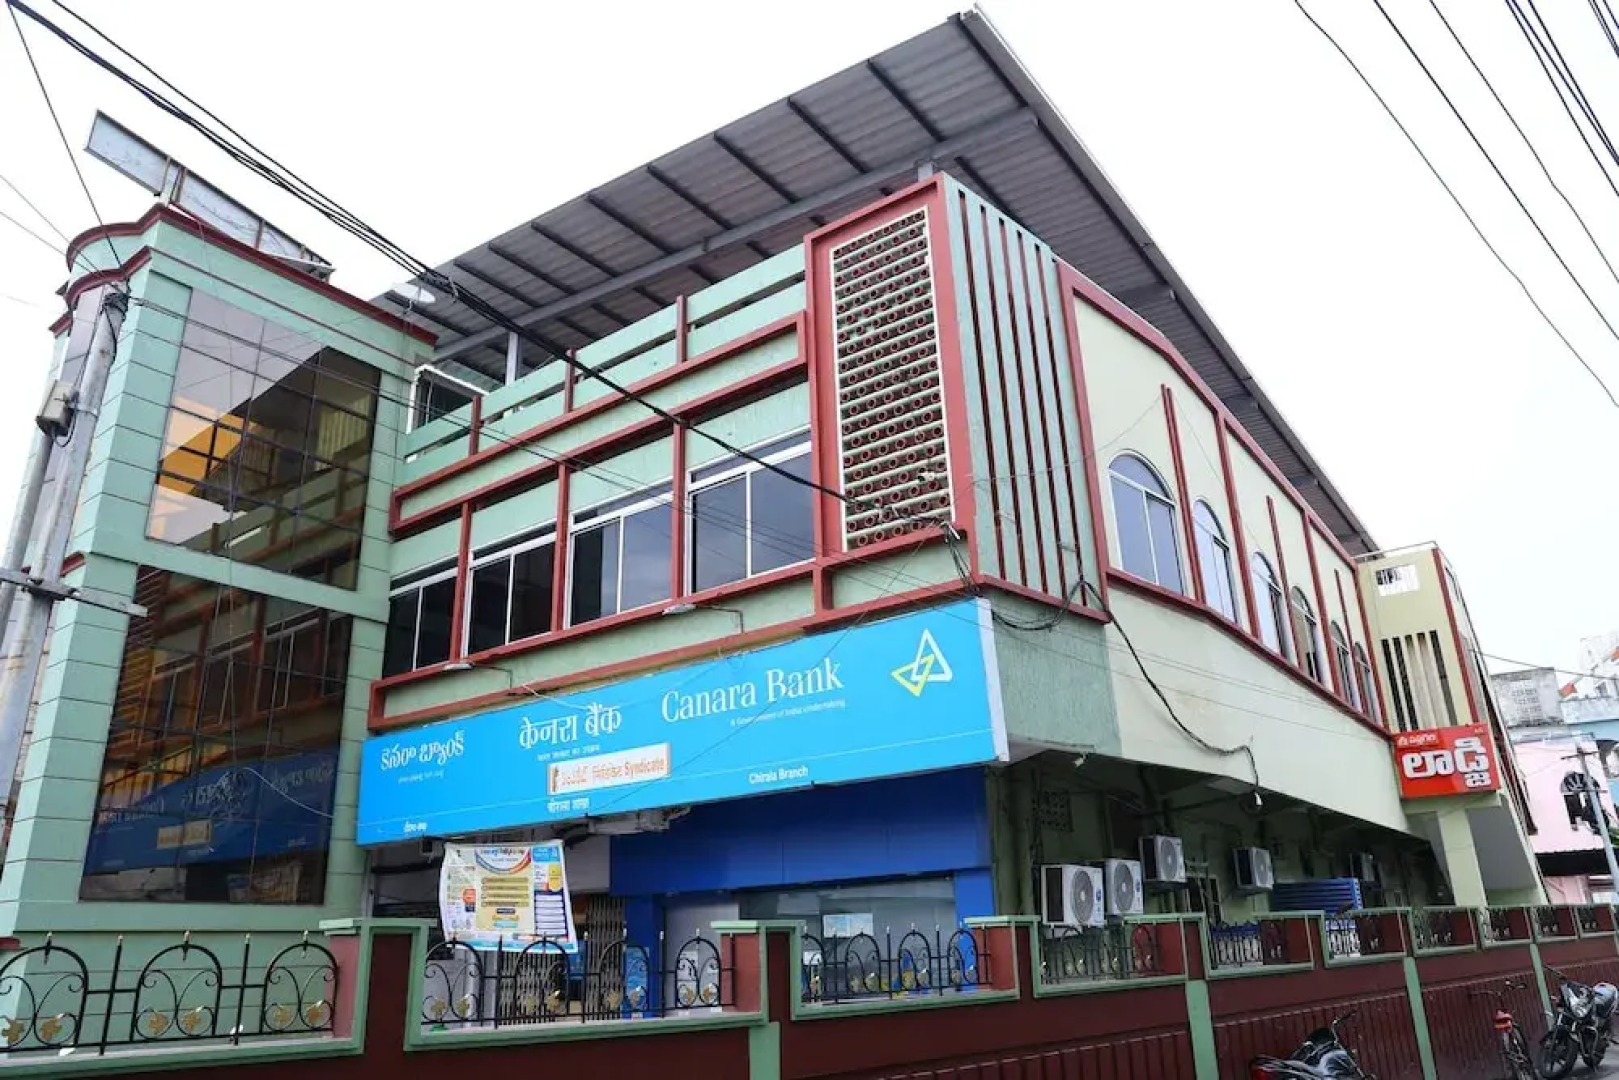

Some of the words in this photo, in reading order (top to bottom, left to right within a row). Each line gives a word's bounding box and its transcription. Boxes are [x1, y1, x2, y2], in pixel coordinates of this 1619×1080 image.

[663, 682, 756, 722] Canara
[767, 657, 843, 702] Bank
[519, 716, 579, 749] केनरा
[585, 702, 622, 736] बैंक
[380, 742, 417, 771] కెనరా
[625, 757, 665, 779] Syndicate
[749, 768, 777, 785] Chirala
[779, 765, 809, 781] Branch
